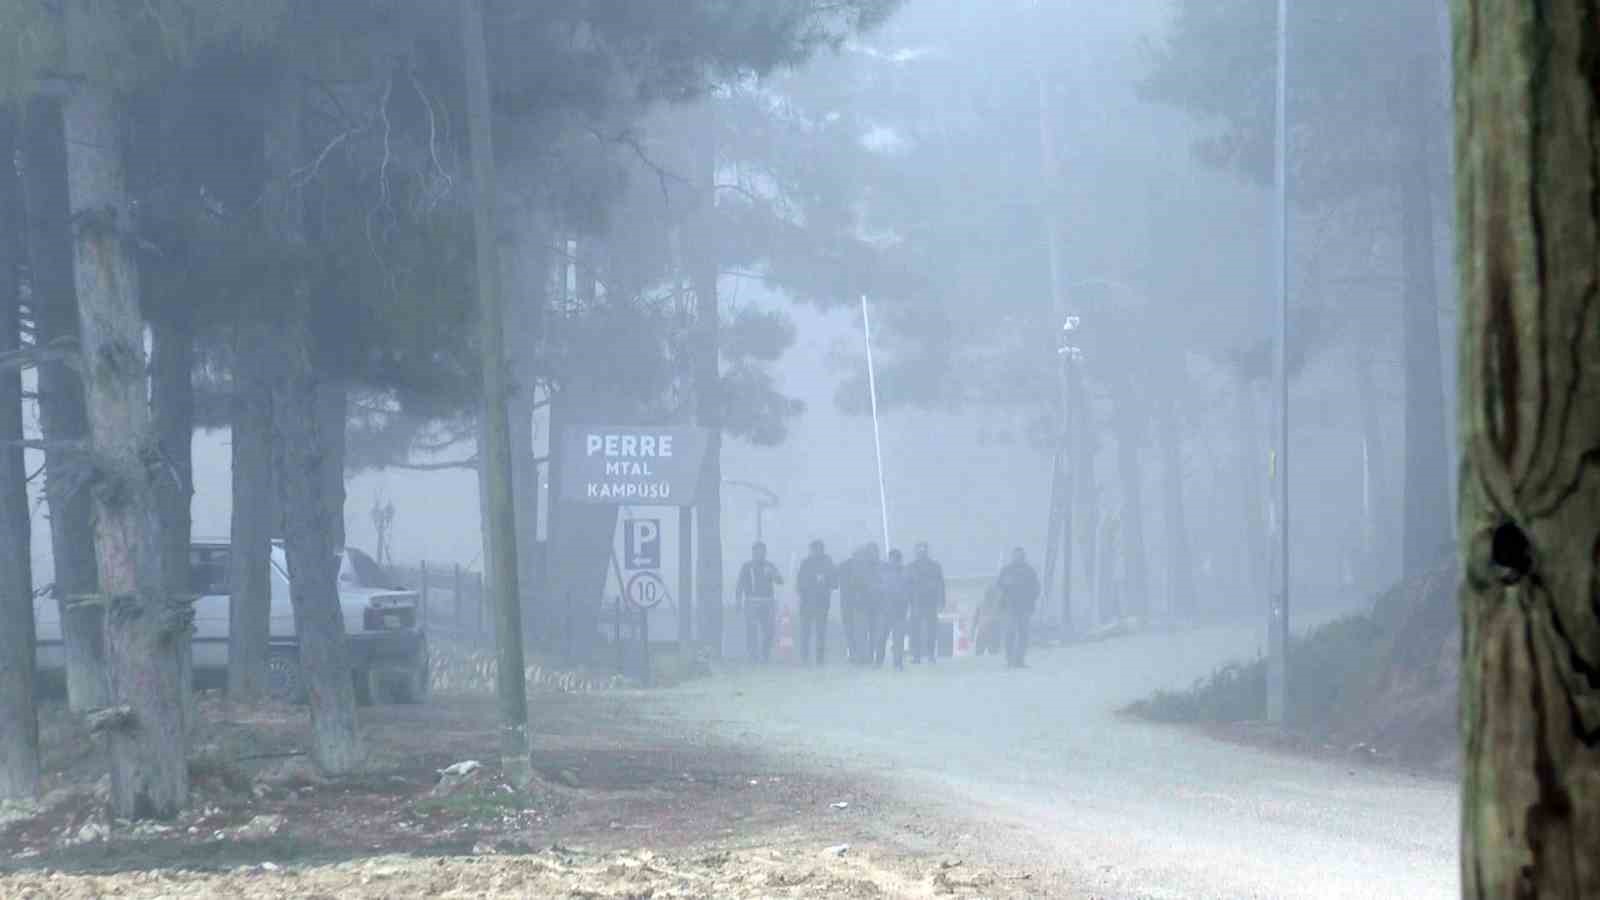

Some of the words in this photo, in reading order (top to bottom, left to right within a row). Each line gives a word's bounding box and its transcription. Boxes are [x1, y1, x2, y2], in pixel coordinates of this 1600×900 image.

[586, 434, 673, 457] PERRE
[605, 461, 652, 476] MTAL
[633, 522, 657, 555] P
[638, 582, 656, 601] 10
